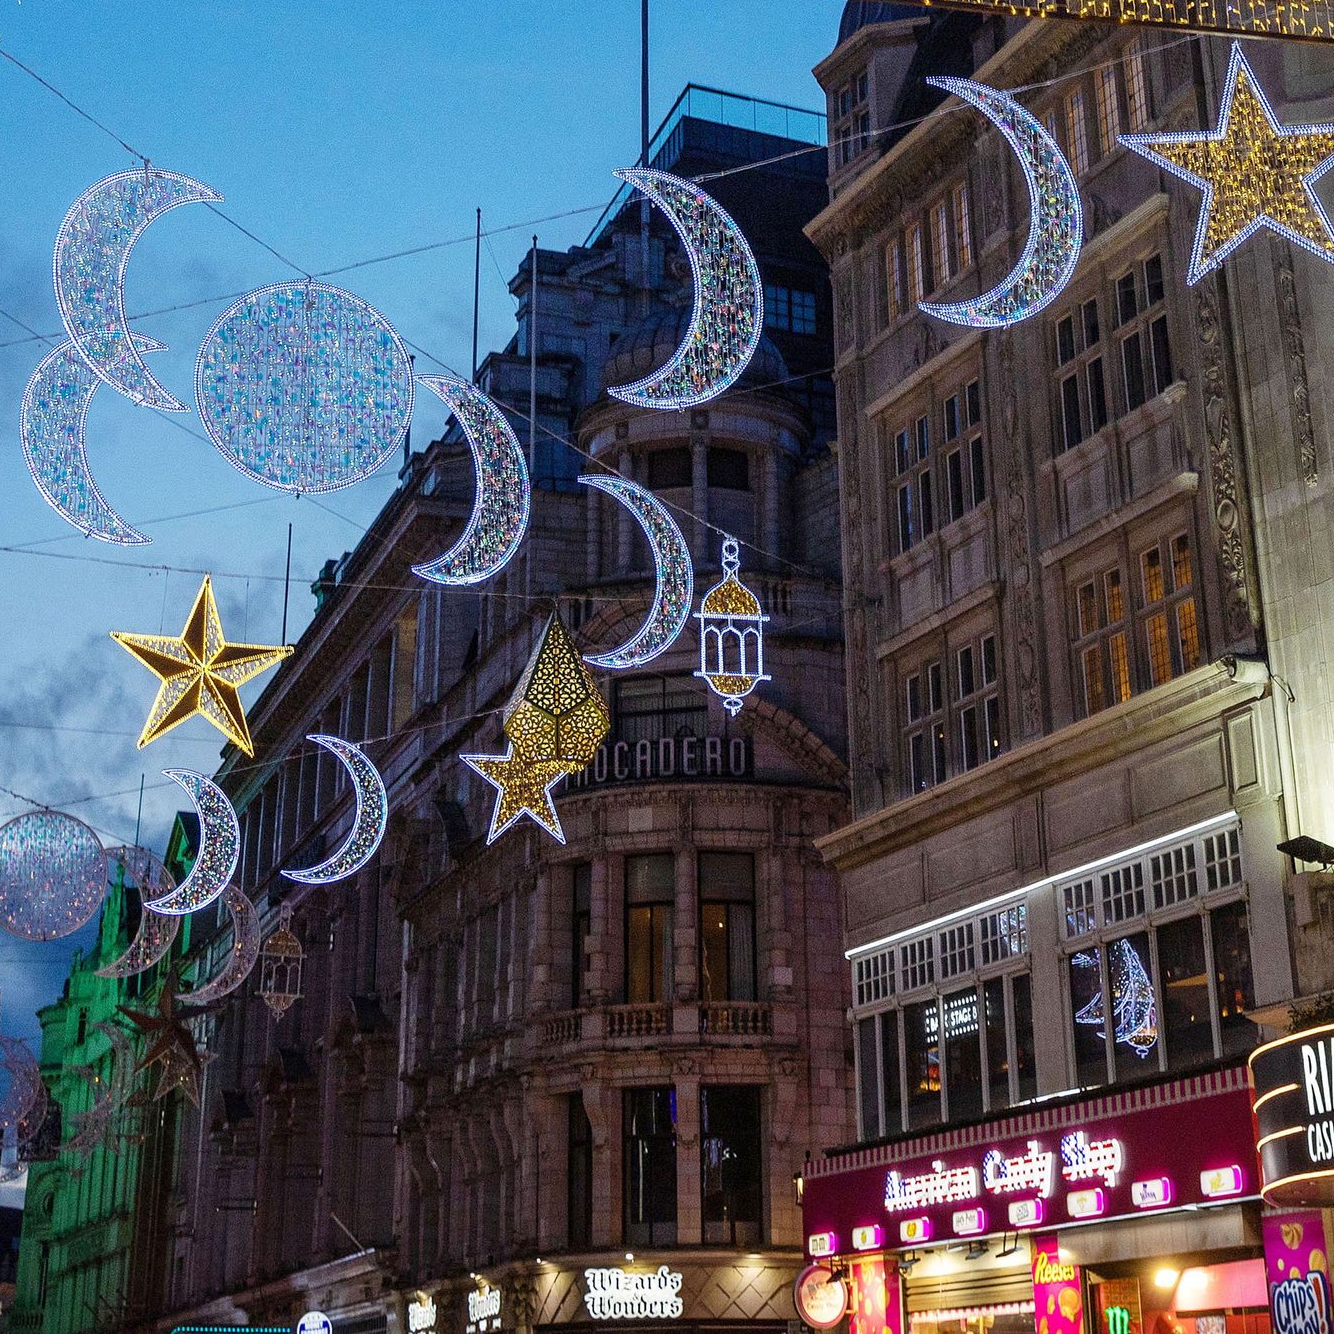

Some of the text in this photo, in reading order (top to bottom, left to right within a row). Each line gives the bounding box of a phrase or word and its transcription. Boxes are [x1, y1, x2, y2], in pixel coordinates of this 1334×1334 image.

[577, 736, 747, 788] OCADERO
[883, 1130, 1122, 1212] American Candy Shop
[586, 1266, 681, 1292] Wizards
[586, 1294, 681, 1317] Wonders
[1275, 1281, 1316, 1333] Chips
